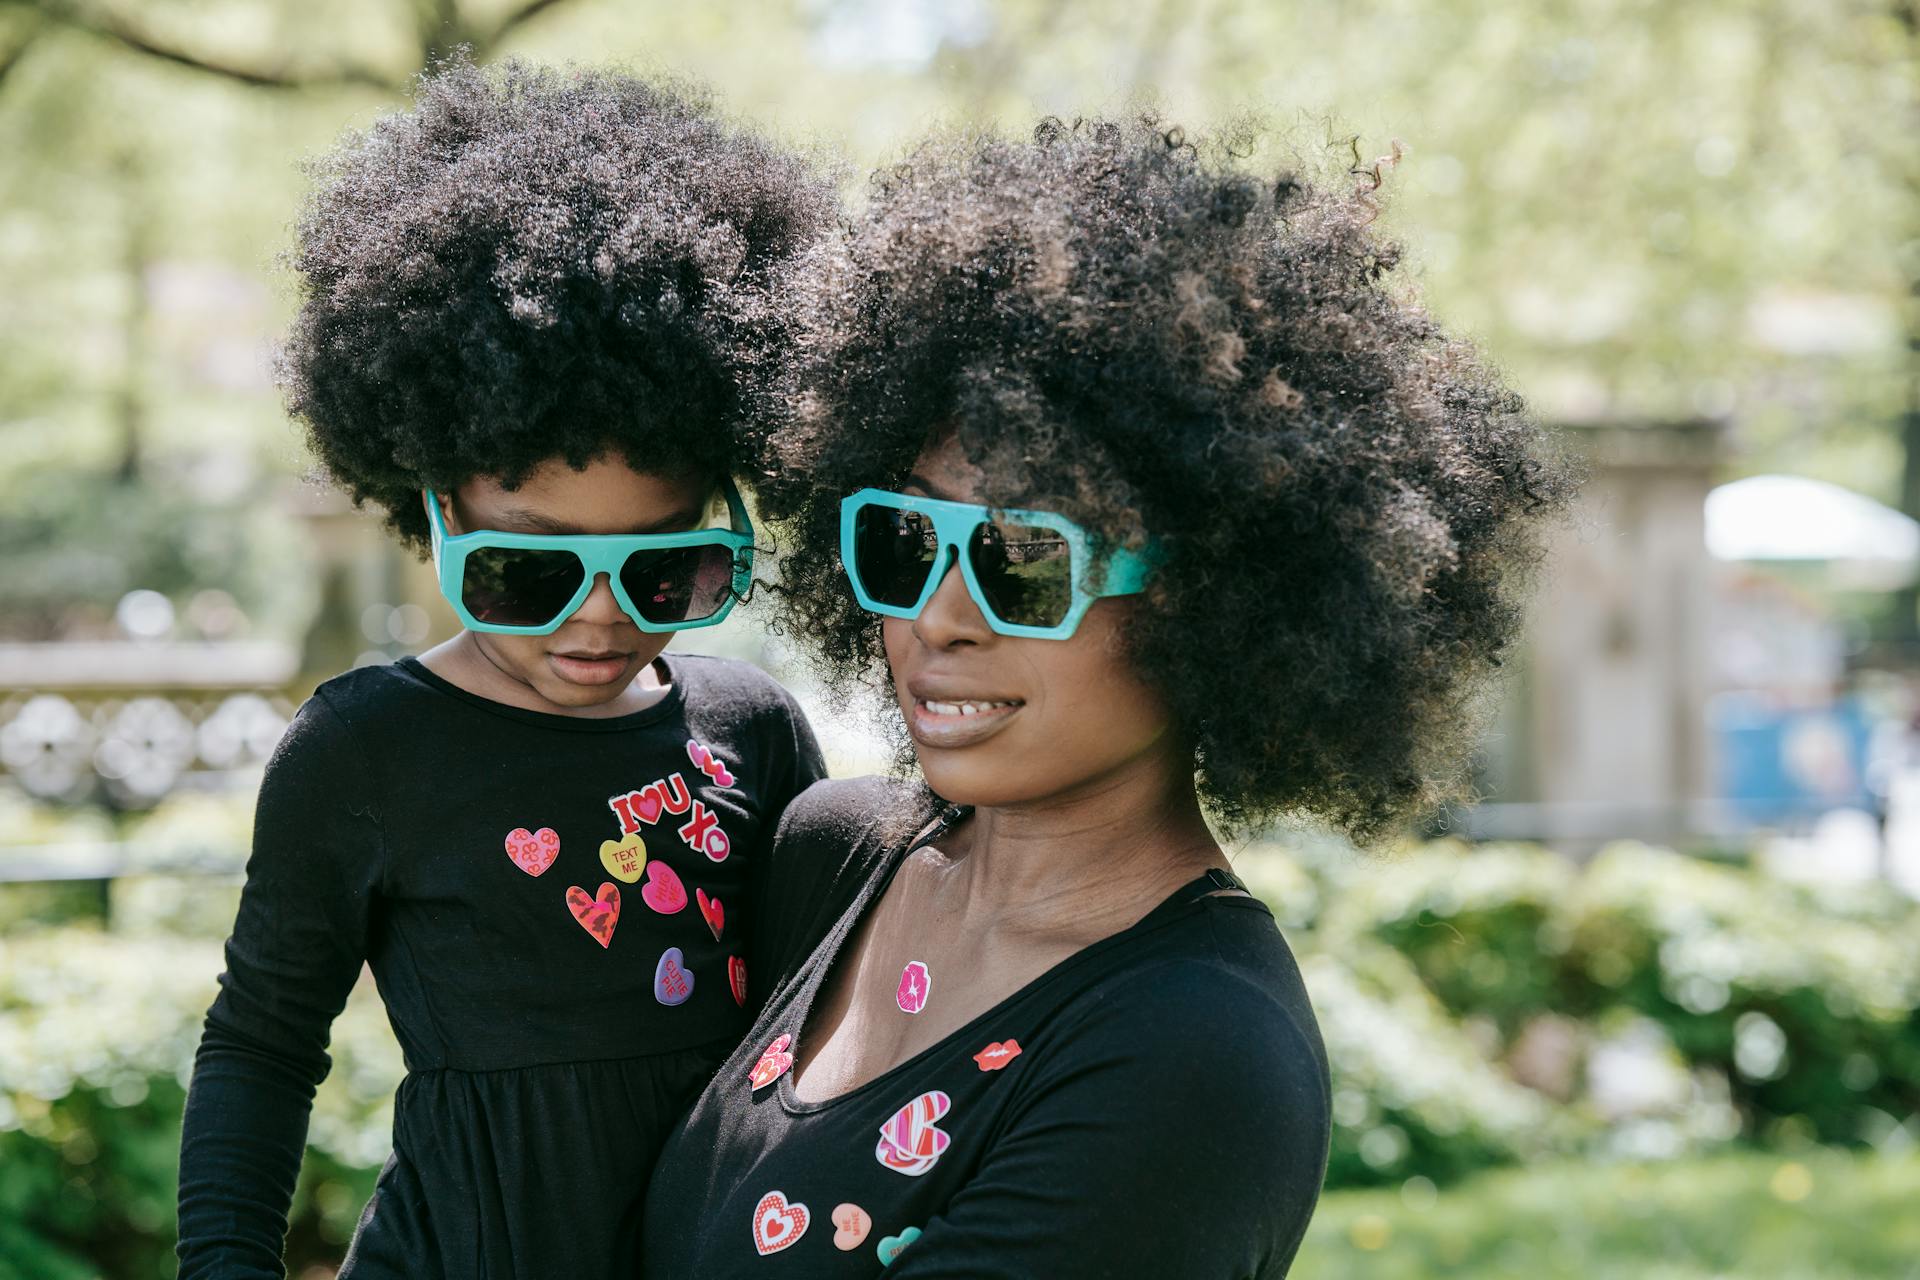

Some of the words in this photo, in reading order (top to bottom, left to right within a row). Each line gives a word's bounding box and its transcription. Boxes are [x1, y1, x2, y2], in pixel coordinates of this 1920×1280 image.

[611, 797, 640, 834] I
[655, 774, 691, 814] U
[612, 846, 638, 863] TEXT
[622, 861, 639, 874] ME
[656, 872, 671, 902] HUG
[668, 882, 681, 903] ME
[661, 977, 676, 998] PIE
[665, 960, 688, 996] CUTIE
